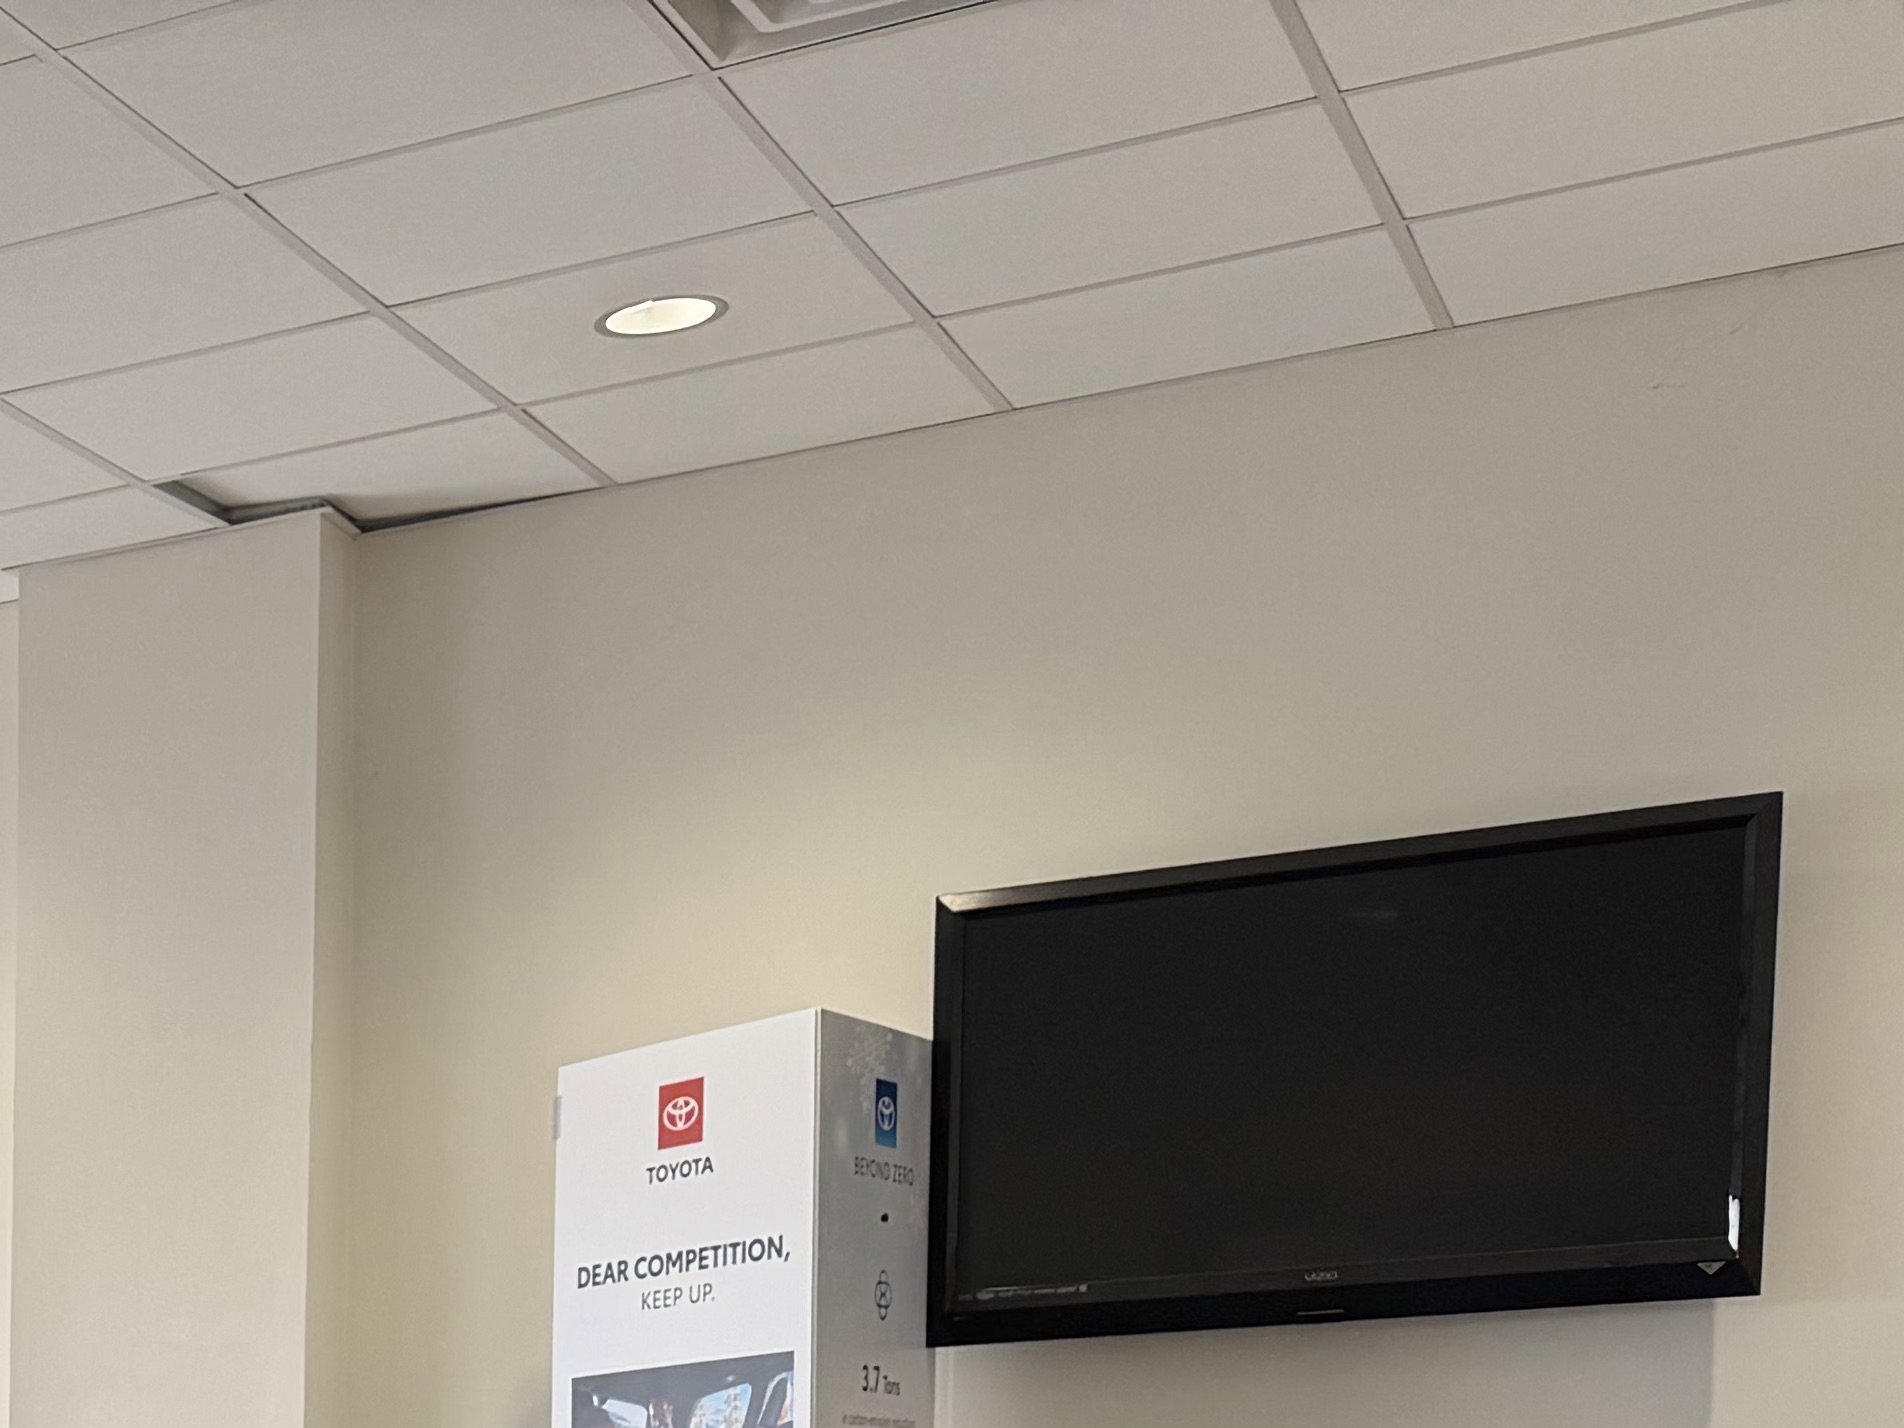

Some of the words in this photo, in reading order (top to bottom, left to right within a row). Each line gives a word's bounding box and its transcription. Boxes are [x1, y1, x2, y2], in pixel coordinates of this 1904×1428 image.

[646, 1156, 714, 1184] TOYOTA
[893, 1163, 914, 1186] ZERO
[577, 1260, 629, 1289] DEAR
[634, 1234, 791, 1280] COMPETITION,
[641, 1287, 682, 1310] KEEP
[689, 1282, 716, 1304] UP.
[862, 1364, 880, 1393] 3.7
